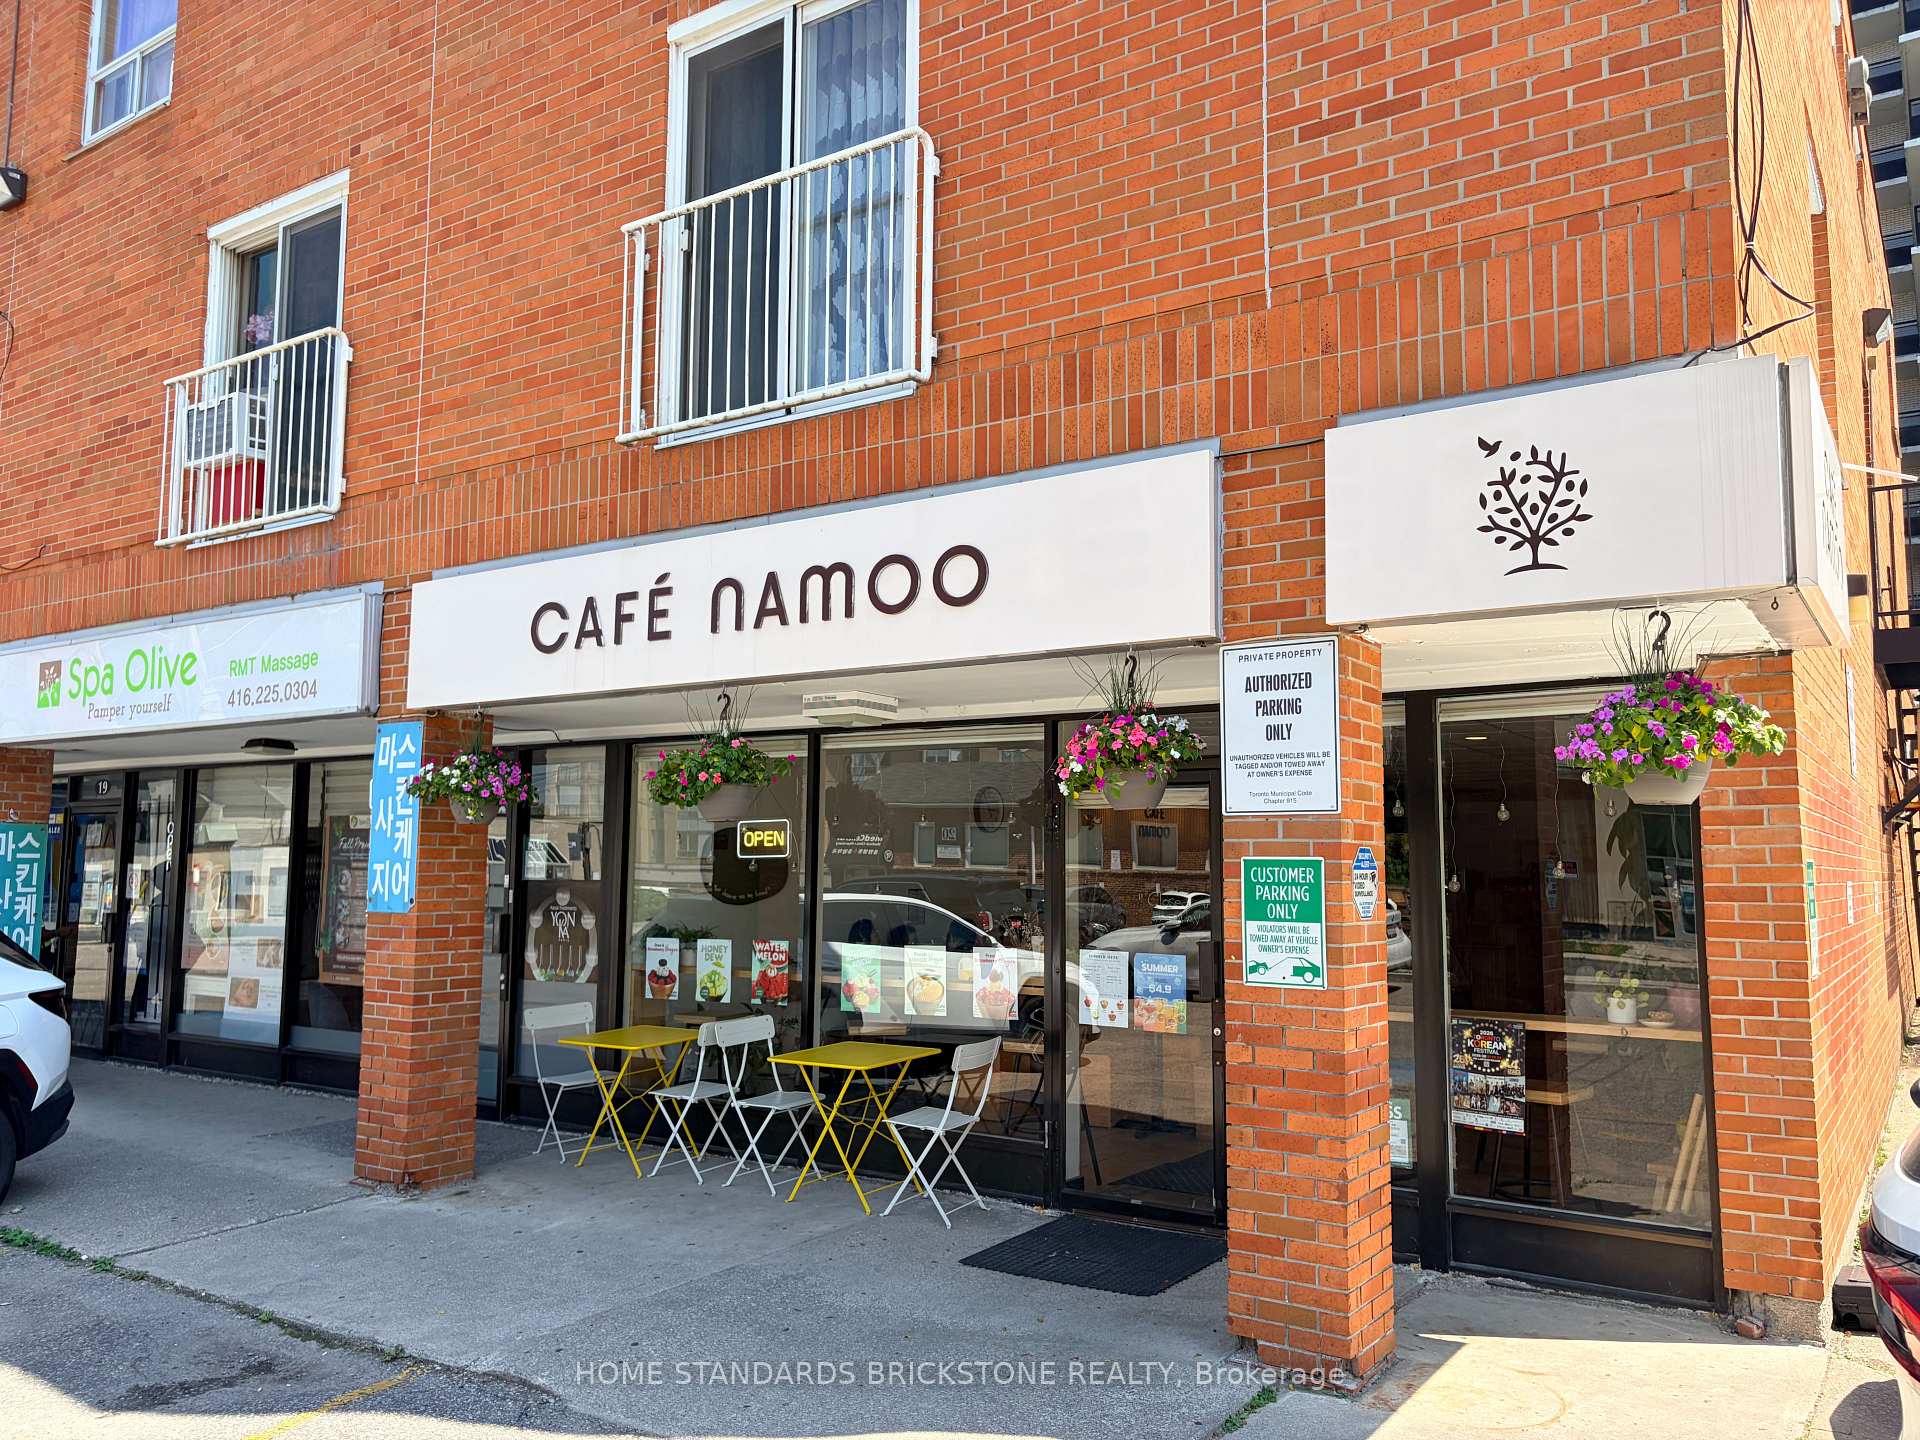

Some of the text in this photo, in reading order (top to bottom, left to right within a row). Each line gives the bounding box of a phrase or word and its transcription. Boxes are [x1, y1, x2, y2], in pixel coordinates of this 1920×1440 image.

[530, 571, 674, 655] CAFÉ
[1238, 648, 1323, 663] PRIVATE PROPERTY
[229, 649, 319, 678] RMT Massage
[67, 644, 198, 707] Spa Olive
[1244, 671, 1312, 694] AUTHORIZED
[227, 679, 318, 709] 416.225.0304
[87, 692, 173, 724] Pamper yourself
[1255, 697, 1302, 717] PARKING
[1265, 723, 1293, 742] ONLY
[1229, 750, 1331, 762] UNAUTHORIZED VEHICLES WILL BE
[1234, 762, 1259, 770] TAGGED
[1259, 761, 1283, 769] AND/OR
[1306, 760, 1326, 768] AWAY
[1256, 770, 1284, 778] OWNER'S
[1284, 769, 1313, 777] EXPENSE
[97, 781, 109, 794] 19
[1270, 790, 1297, 798] Municipal
[743, 830, 785, 847] OPEN
[1250, 866, 1315, 884] CUSTOMER
[1255, 885, 1310, 902] PARKING
[1267, 903, 1299, 920] ONLY
[1256, 924, 1310, 935] VIOLATORS WILL BE
[1249, 933, 1319, 945] TOWED AWAY AT VEHICLE
[700, 943, 729, 953] HONEY
[755, 941, 787, 952] WATER
[1258, 944, 1310, 955] OWNER'S EXPENSE
[704, 952, 724, 963] DEW
[755, 951, 786, 962] MELON
[1141, 963, 1179, 974] SUMMER
[1467, 1039, 1507, 1051] KOREAN
[1473, 1047, 1500, 1056] FESTIVAL
